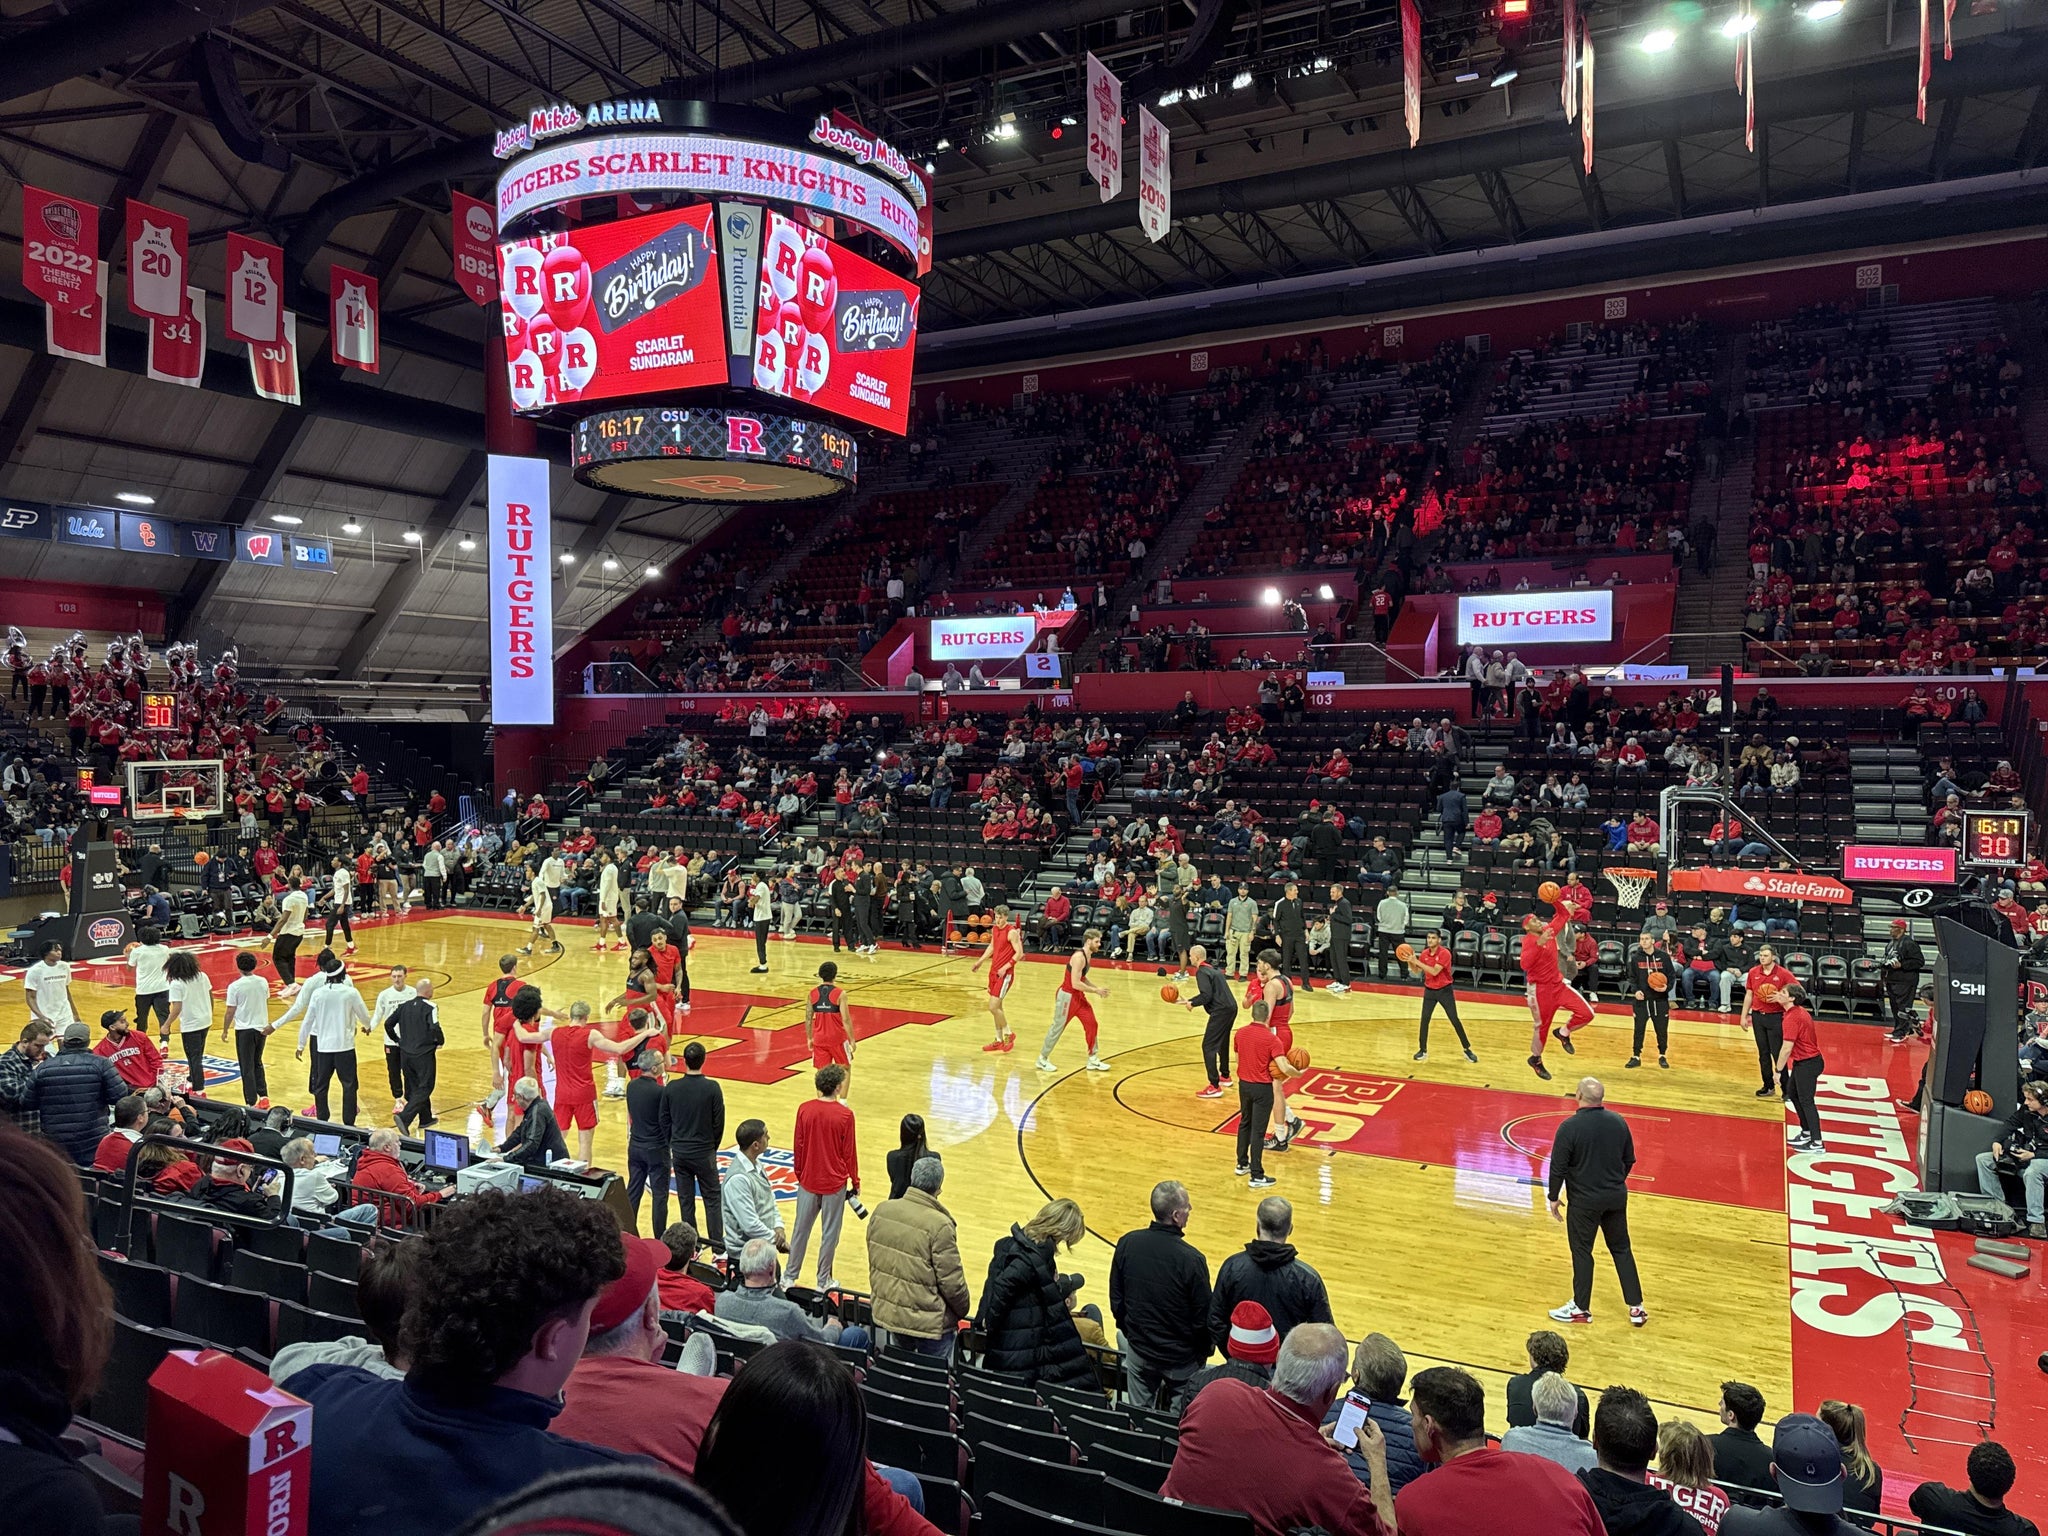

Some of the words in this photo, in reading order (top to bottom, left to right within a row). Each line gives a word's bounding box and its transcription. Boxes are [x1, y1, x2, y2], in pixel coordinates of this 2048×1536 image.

[494, 123, 528, 156] Jersey
[530, 105, 581, 136] Mike's
[588, 102, 661, 124] ARENA
[815, 116, 872, 161] Jersey
[1091, 133, 1117, 171] 2019
[501, 160, 581, 212] RUTGERS
[589, 153, 734, 176] SCARLET
[743, 157, 867, 206] KNIGHTS
[1141, 179, 1165, 213] 2019
[469, 221, 493, 235] NCAA
[29, 241, 93, 275] 2022
[142, 249, 171, 277] 20
[630, 250, 657, 269] HAPPY
[776, 242, 796, 281] R
[40, 266, 82, 283] THERESA
[43, 275, 81, 290] GRENTZ
[515, 266, 538, 295] R
[1858, 268, 1879, 277] 302
[1859, 277, 1879, 286] 202
[57, 291, 70, 303] R
[244, 278, 267, 306] 12
[553, 272, 578, 302] R
[733, 246, 748, 330] Prudential
[806, 271, 825, 306] R
[864, 297, 883, 309] HAPPY
[1607, 300, 1625, 309] 303
[1607, 308, 1625, 317] 203
[346, 305, 366, 330] 14
[162, 320, 192, 344] 34
[784, 320, 798, 346] R
[1386, 328, 1401, 337] 304
[536, 333, 555, 355] R
[636, 335, 684, 354] SCARLET
[566, 343, 588, 368] R
[630, 349, 694, 371] SUNDARAM
[759, 341, 776, 372] R
[806, 346, 821, 375] R
[515, 365, 534, 389] R
[856, 371, 887, 394] SCARLET
[850, 384, 891, 409] SUNDARAM
[599, 416, 644, 438] 16:17
[661, 411, 689, 422] OSU
[672, 424, 680, 442] 1
[726, 416, 766, 455] R
[791, 421, 806, 434] RU
[581, 434, 587, 452] 2
[610, 441, 628, 452] 1ST
[793, 434, 803, 453] 2
[821, 432, 850, 457] 16:17
[1, 508, 39, 529] P
[192, 531, 217, 552] W
[247, 535, 272, 560] W
[506, 503, 535, 680] RUTGERS
[1375, 597, 1385, 606] 22
[59, 603, 76, 613] 108
[1473, 609, 1596, 628] RUTGERS
[941, 631, 1025, 646] RUTGERS
[147, 695, 174, 707] 16:17
[680, 700, 695, 710] 106
[1310, 694, 1333, 706] 103
[1697, 689, 1718, 701] 02
[148, 707, 171, 727] 30
[1978, 818, 2019, 835] 16:17
[1980, 837, 2010, 857] 30
[1854, 857, 1944, 871] RUTGERS
[1959, 983, 1985, 996] SHI
[264, 1420, 297, 1465] R
[167, 1471, 205, 1536] R
[1649, 1476, 1729, 1523] TGER
